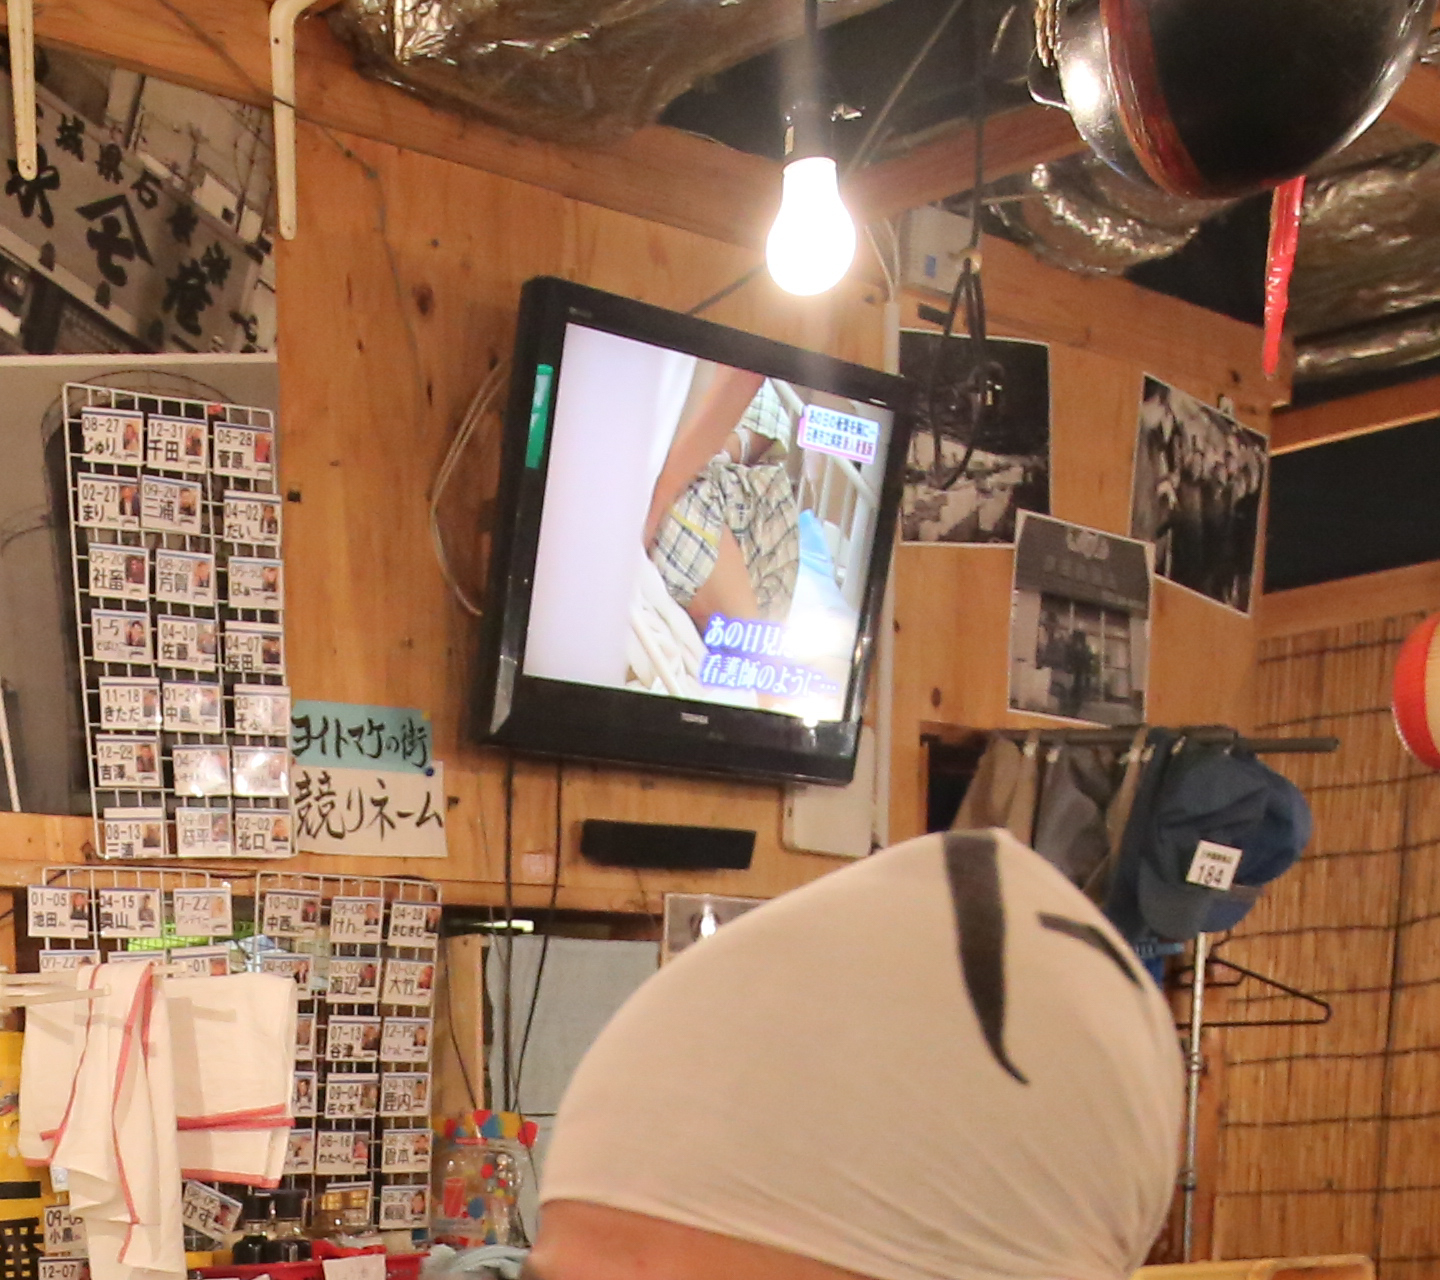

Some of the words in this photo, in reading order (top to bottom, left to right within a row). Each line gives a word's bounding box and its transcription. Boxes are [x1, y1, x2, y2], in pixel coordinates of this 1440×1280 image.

[83, 416, 119, 432] 08-27
[150, 423, 183, 438] 12-31
[148, 439, 178, 462] 千田
[82, 484, 117, 500] 02-27
[82, 505, 104, 522] まり
[105, 688, 139, 702] 11-18
[291, 715, 427, 769] ヨイトマケの街
[295, 770, 443, 841] 競りネーム
[239, 817, 269, 832] 02-02
[31, 892, 67, 907] 01-05
[42, 1265, 76, 1278] 12-07
